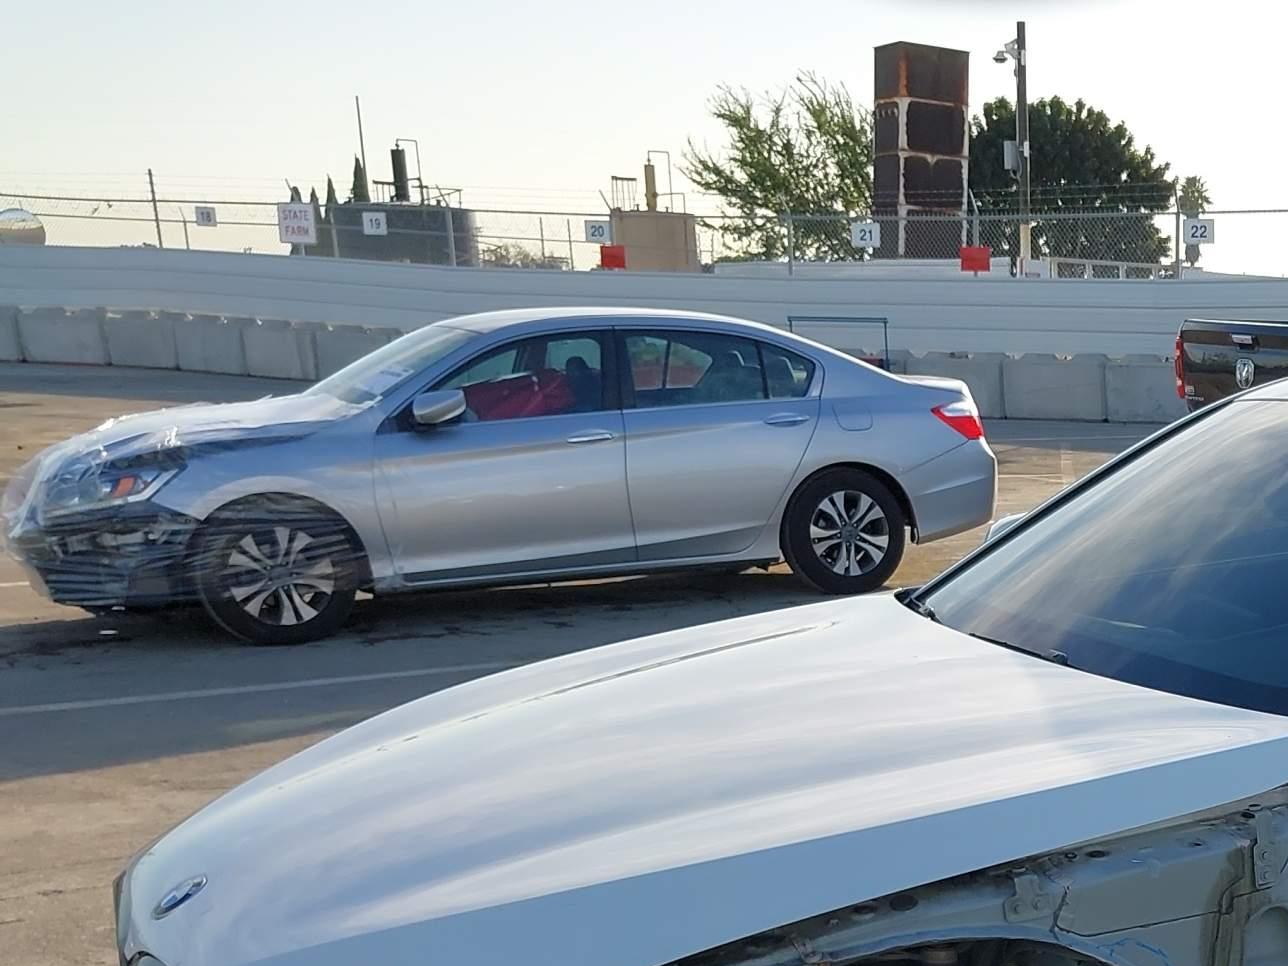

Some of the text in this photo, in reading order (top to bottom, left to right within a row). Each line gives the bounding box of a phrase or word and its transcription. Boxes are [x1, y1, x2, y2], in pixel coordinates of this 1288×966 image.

[282, 209, 309, 221] STATE
[369, 217, 381, 230] 19
[285, 225, 309, 236] FARM
[590, 225, 605, 237] 20
[860, 229, 873, 241] 21
[1190, 225, 1207, 238] 22
